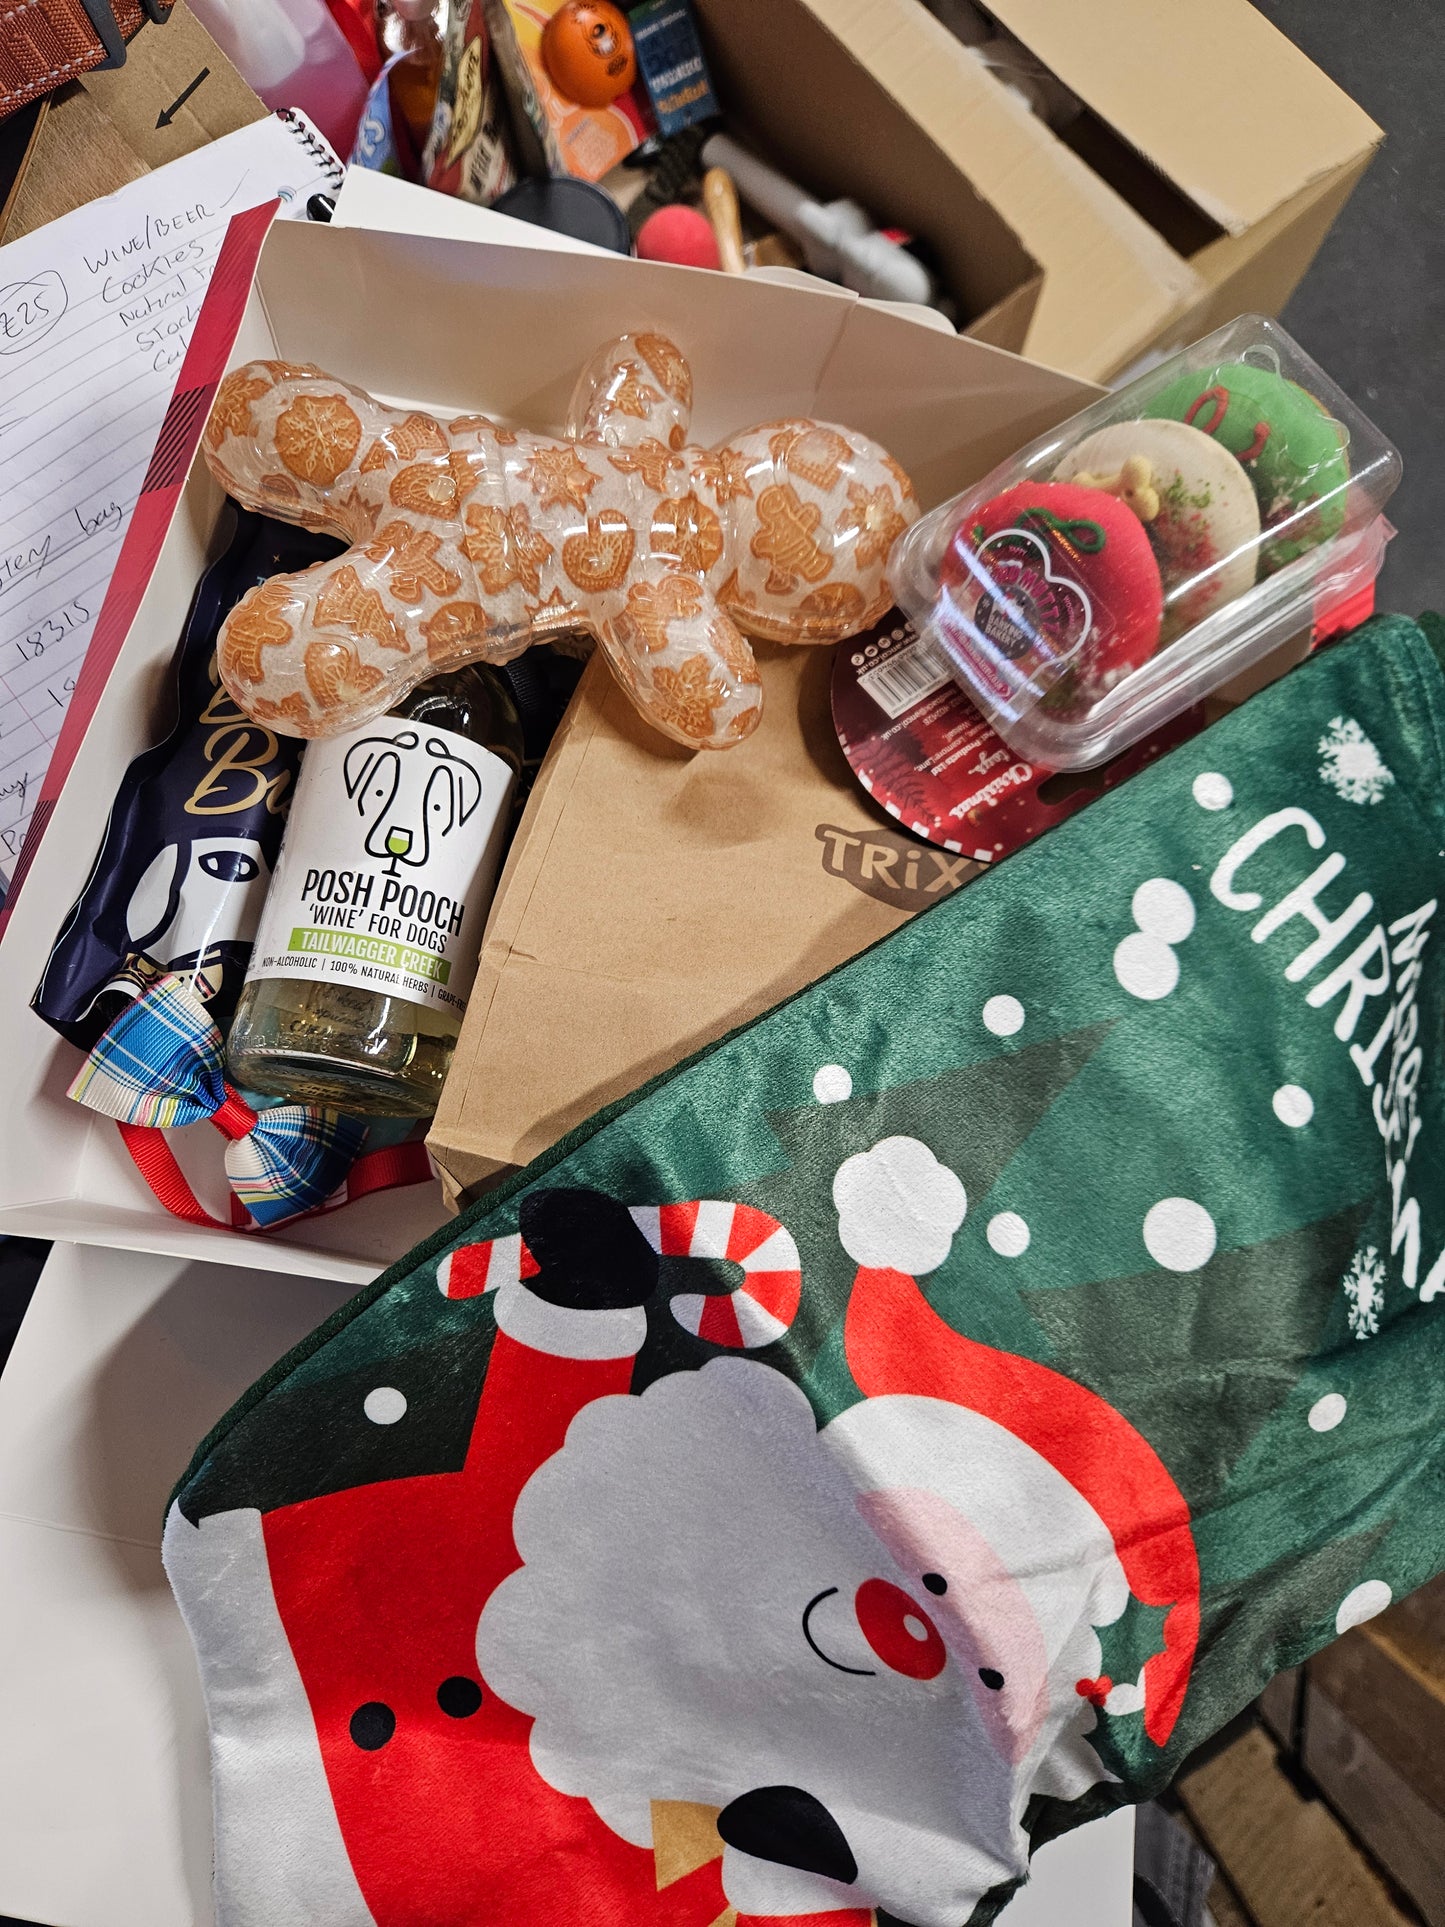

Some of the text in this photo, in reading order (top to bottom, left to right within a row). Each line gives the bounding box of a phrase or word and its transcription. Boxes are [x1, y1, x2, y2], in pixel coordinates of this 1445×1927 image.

[83, 204, 215, 275] WINE/BEER
[75, 502, 123, 536] bag
[929, 761, 948, 778] Ltd
[945, 739, 982, 766] Products
[948, 762, 1034, 820] Christmas
[301, 869, 465, 937] POSH POOCH
[368, 914, 401, 939] FOR
[406, 923, 448, 954] DOGS
[262, 954, 318, 969] NON-ALCOHOLIC
[330, 960, 358, 976] 100%
[360, 966, 401, 985] NATURAL
[402, 975, 430, 994] HERBS
[301, 931, 443, 980] TAILWAGGER CREEK
